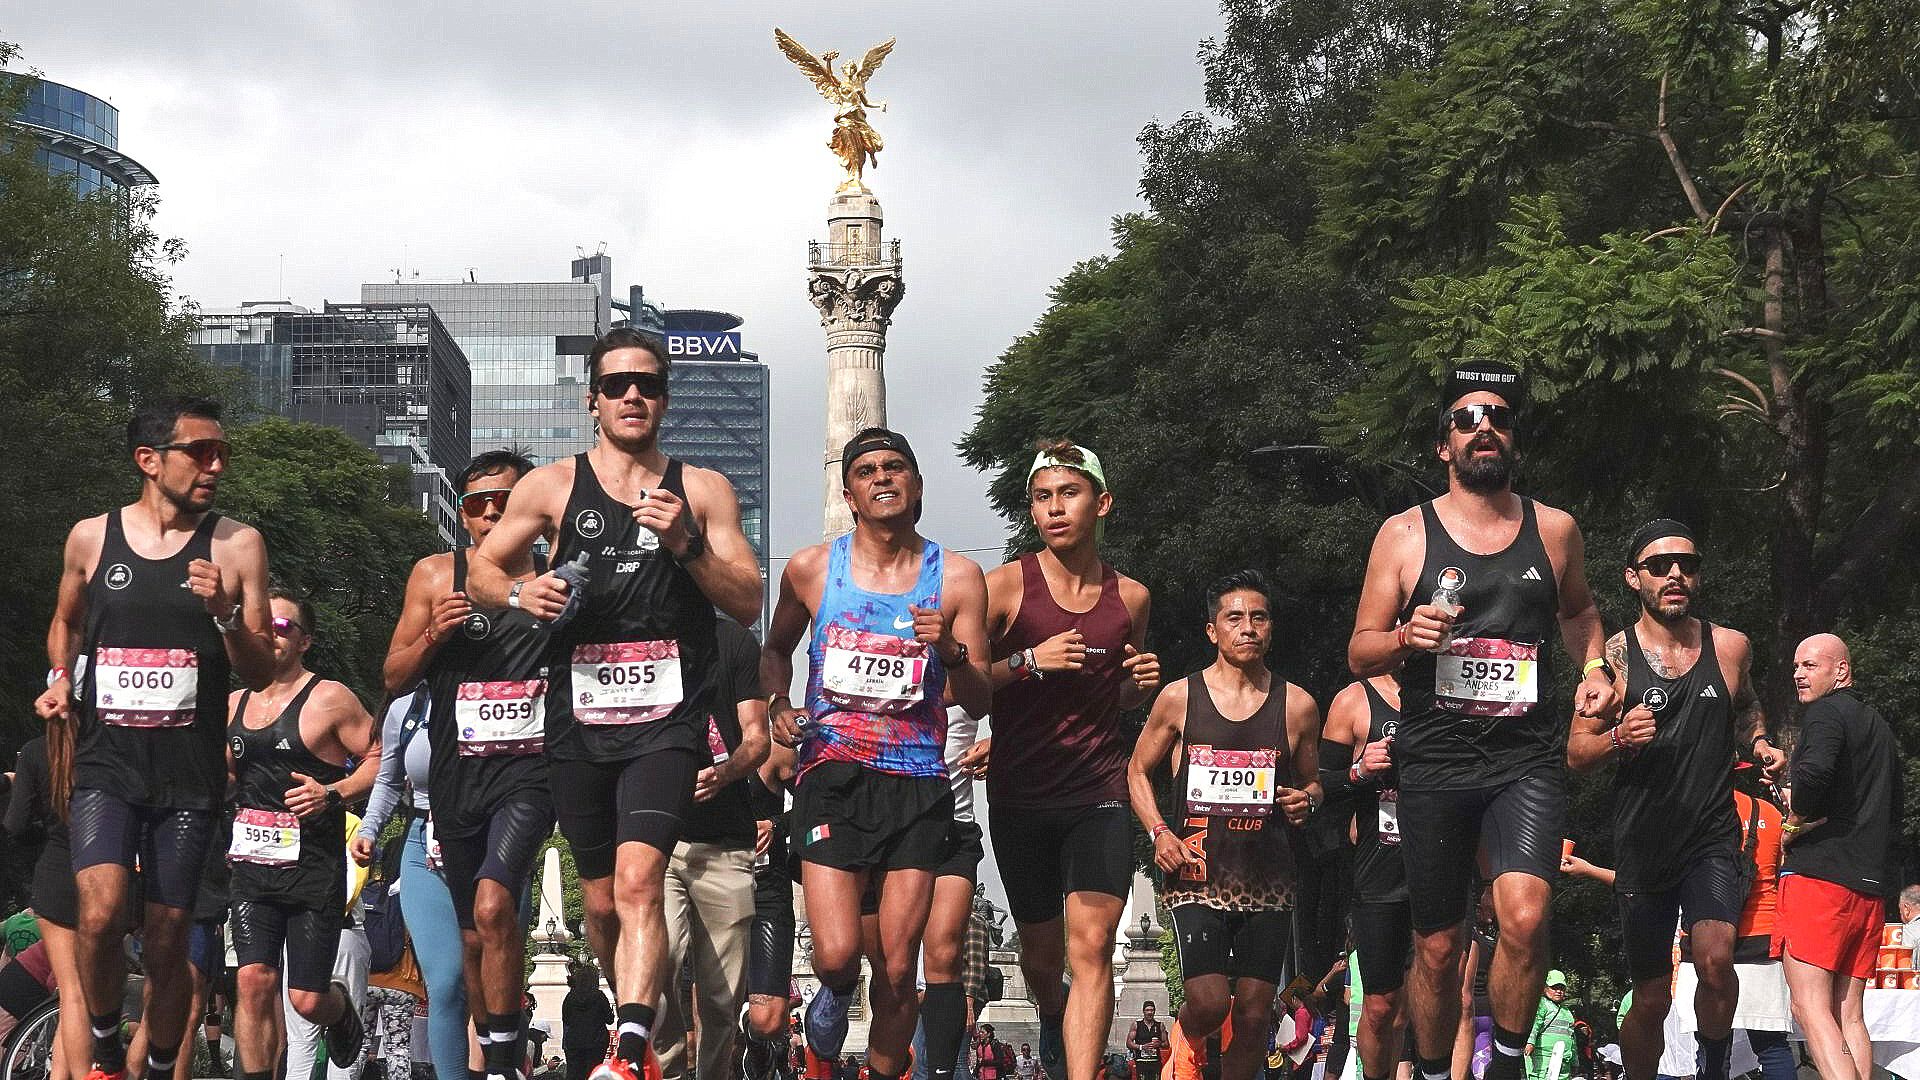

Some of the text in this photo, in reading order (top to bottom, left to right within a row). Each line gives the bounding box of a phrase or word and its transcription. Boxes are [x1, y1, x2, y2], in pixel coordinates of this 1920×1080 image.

[668, 334, 738, 356] BBVA
[1456, 370, 1517, 383] TRUST YOUR GUT
[616, 561, 640, 573] DRP
[597, 664, 656, 686] 6055
[848, 655, 905, 678] 4798
[1460, 660, 1515, 682] 5952
[118, 670, 174, 689] 6060
[1464, 679, 1499, 691] ANDRES
[479, 701, 532, 721] 6059
[1208, 769, 1255, 786] 7190
[1228, 817, 1263, 831] CLUB
[245, 827, 282, 843] 5954
